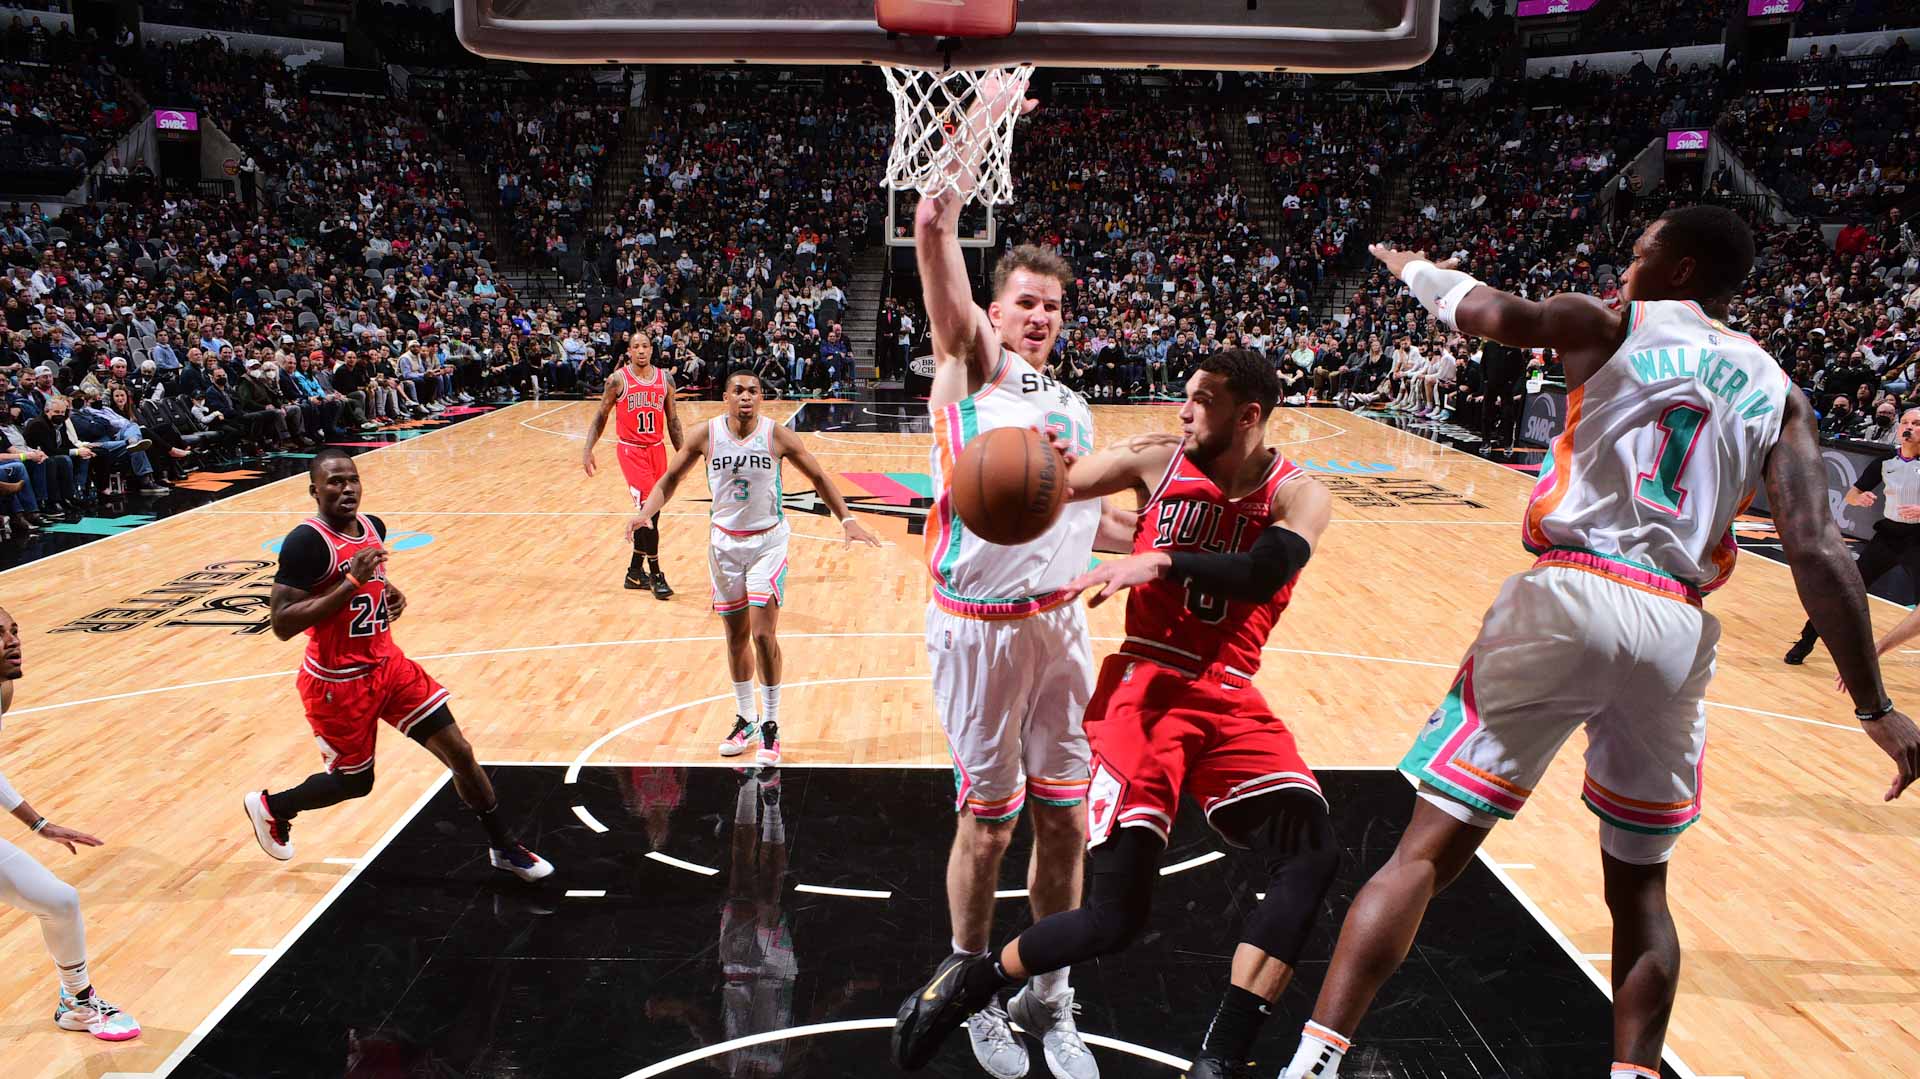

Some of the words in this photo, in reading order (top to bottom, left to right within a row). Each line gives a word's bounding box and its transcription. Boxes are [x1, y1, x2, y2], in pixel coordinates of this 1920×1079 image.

[1761, 4, 1789, 15] SWBC
[160, 119, 188, 130] SWBC
[1675, 139, 1704, 150] SWBC
[1629, 347, 1748, 405] WALKER
[1735, 389, 1774, 420] IV
[627, 391, 664, 412] BULLS
[637, 411, 655, 434] 11
[712, 455, 771, 474] SPURS
[1634, 401, 1710, 518] 1
[734, 478, 751, 501] 3
[1153, 500, 1249, 555] BULL
[349, 593, 389, 638] 24
